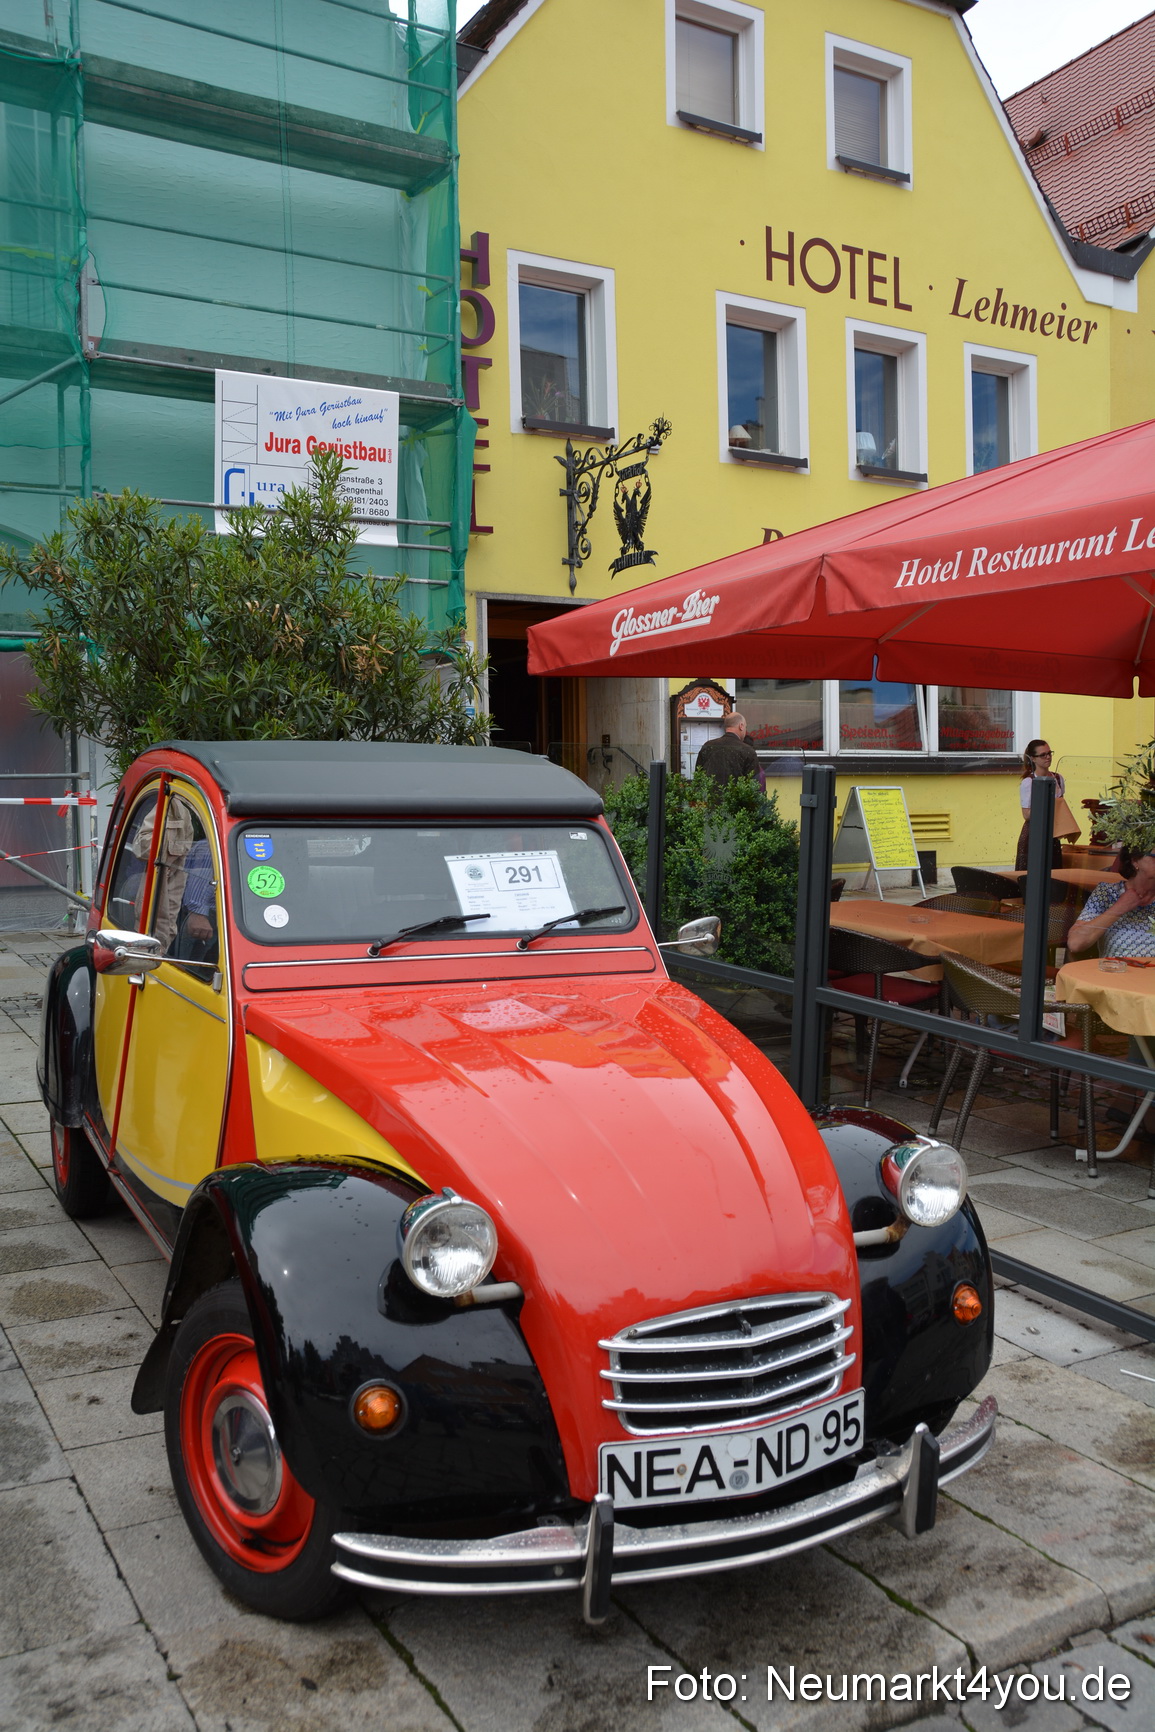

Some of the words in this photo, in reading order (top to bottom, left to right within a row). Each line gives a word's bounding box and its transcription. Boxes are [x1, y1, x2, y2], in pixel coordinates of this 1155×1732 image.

[765, 225, 913, 312] HOTEL
[949, 277, 1098, 345] Lehmeier
[295, 406, 317, 421] Jura
[319, 396, 363, 416] Gerüstbau
[331, 415, 352, 429] hoch
[265, 432, 301, 454] Jura
[306, 435, 387, 463] Gerüstbau
[340, 485, 383, 496] Sengenthal
[377, 477, 383, 486] 3
[343, 496, 389, 507] 09181/2403
[894, 550, 963, 588] Hotel
[966, 526, 1118, 578] Restaurant
[609, 589, 720, 657] Glossner-Bier
[255, 873, 278, 890] 52
[505, 865, 543, 884] 291
[823, 1400, 861, 1455] 95
